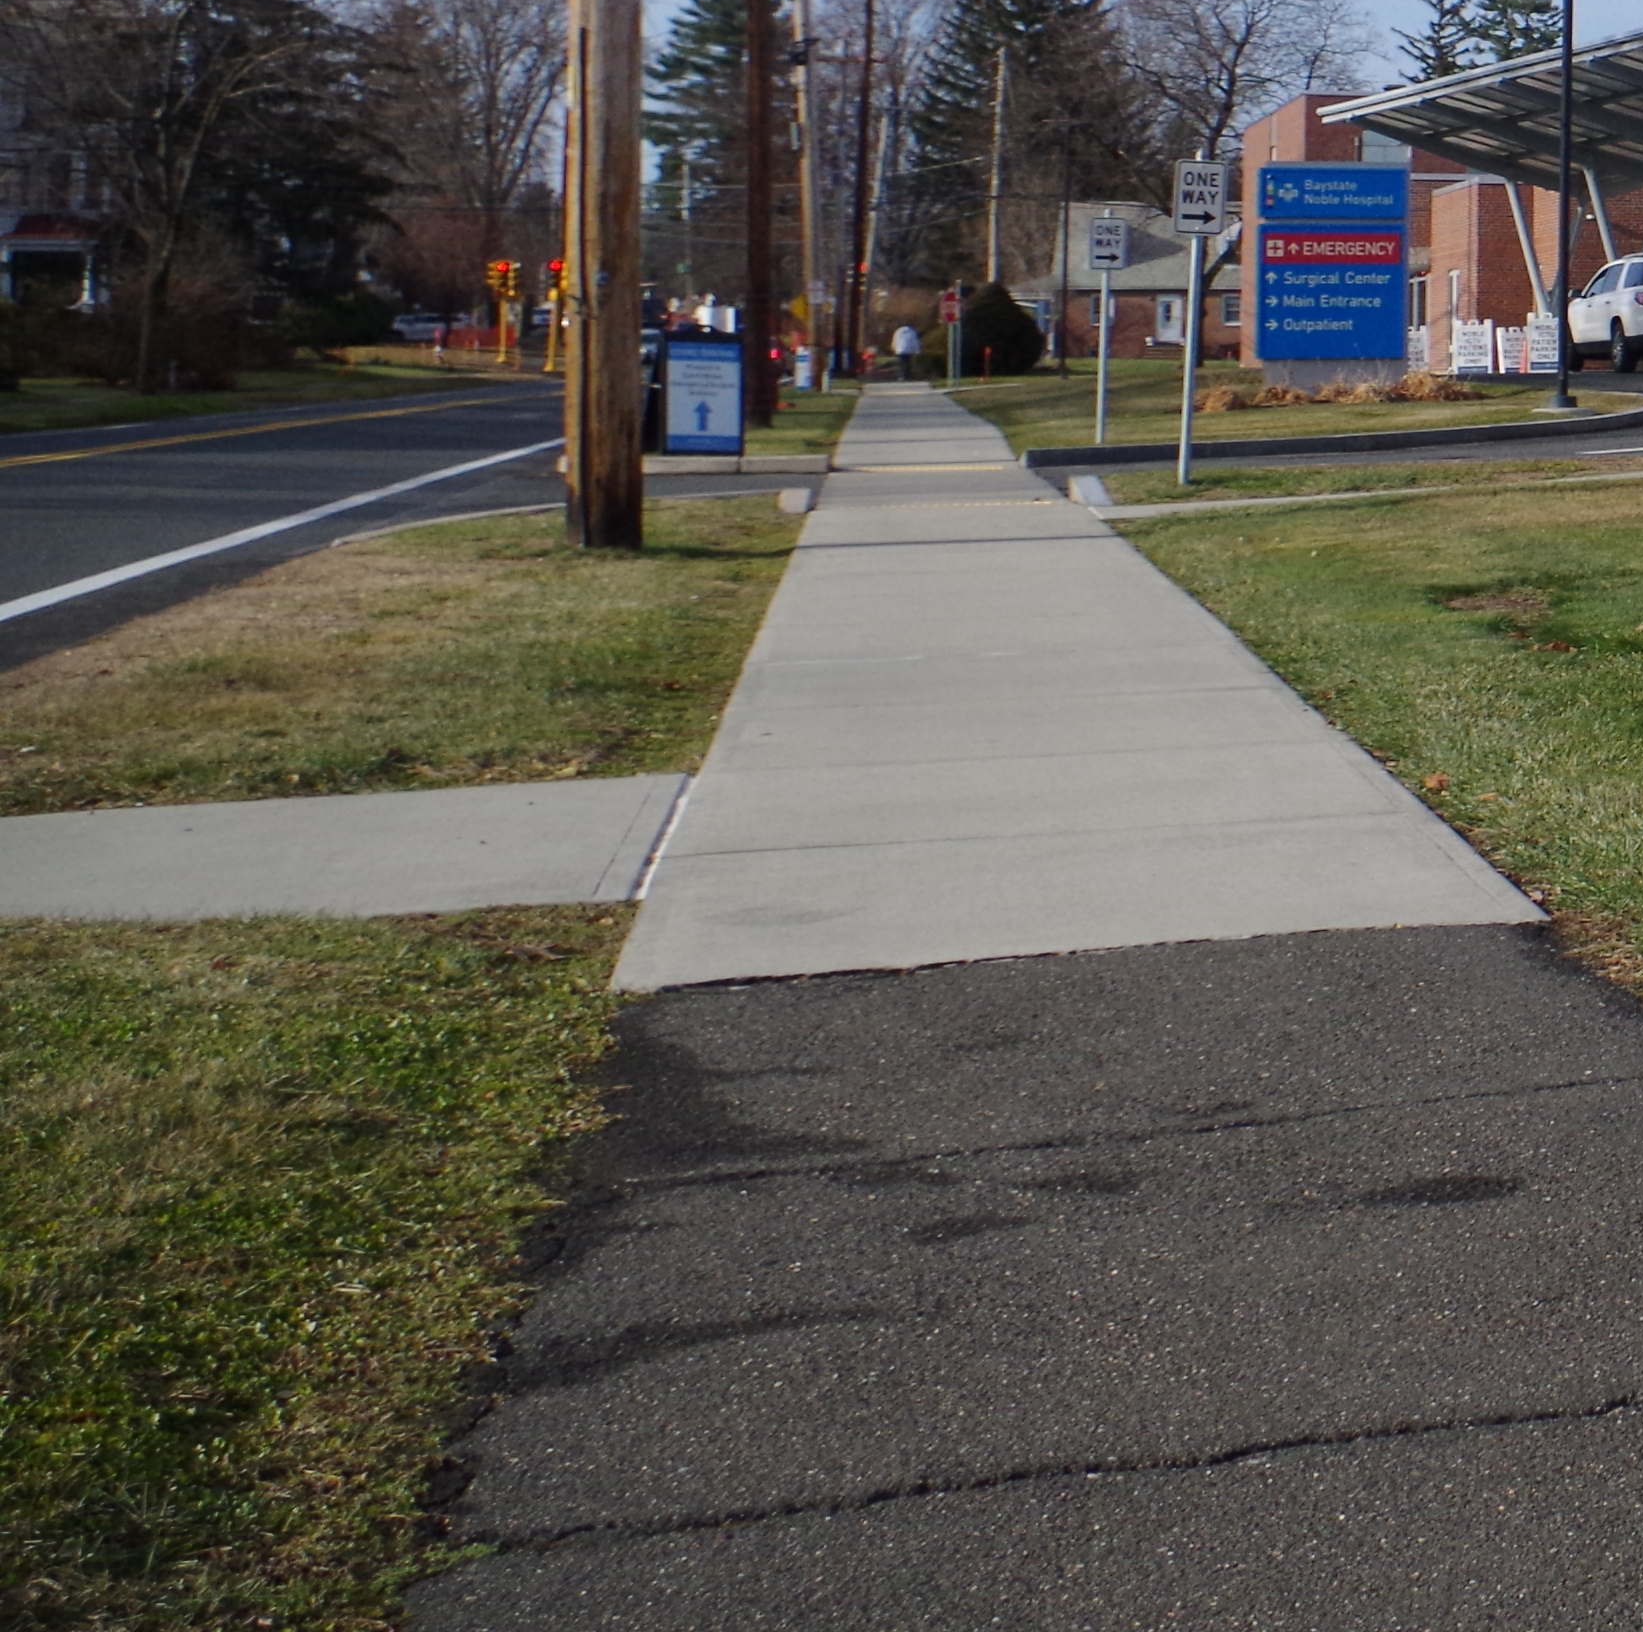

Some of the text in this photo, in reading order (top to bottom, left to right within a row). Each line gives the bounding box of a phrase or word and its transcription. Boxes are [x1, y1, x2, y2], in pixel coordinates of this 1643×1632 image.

[1183, 171, 1220, 188] ONE
[1303, 179, 1358, 193] Baystate
[1181, 190, 1219, 205] WAY
[1303, 194, 1394, 207] Noble Hospital
[1095, 224, 1121, 237] ONE
[1094, 239, 1121, 249] WAY
[1303, 241, 1396, 256] EMERGENCY
[1283, 271, 1391, 288] Surgical Center
[1283, 295, 1381, 308] Main Entrance
[1283, 318, 1354, 333] Outpatient
